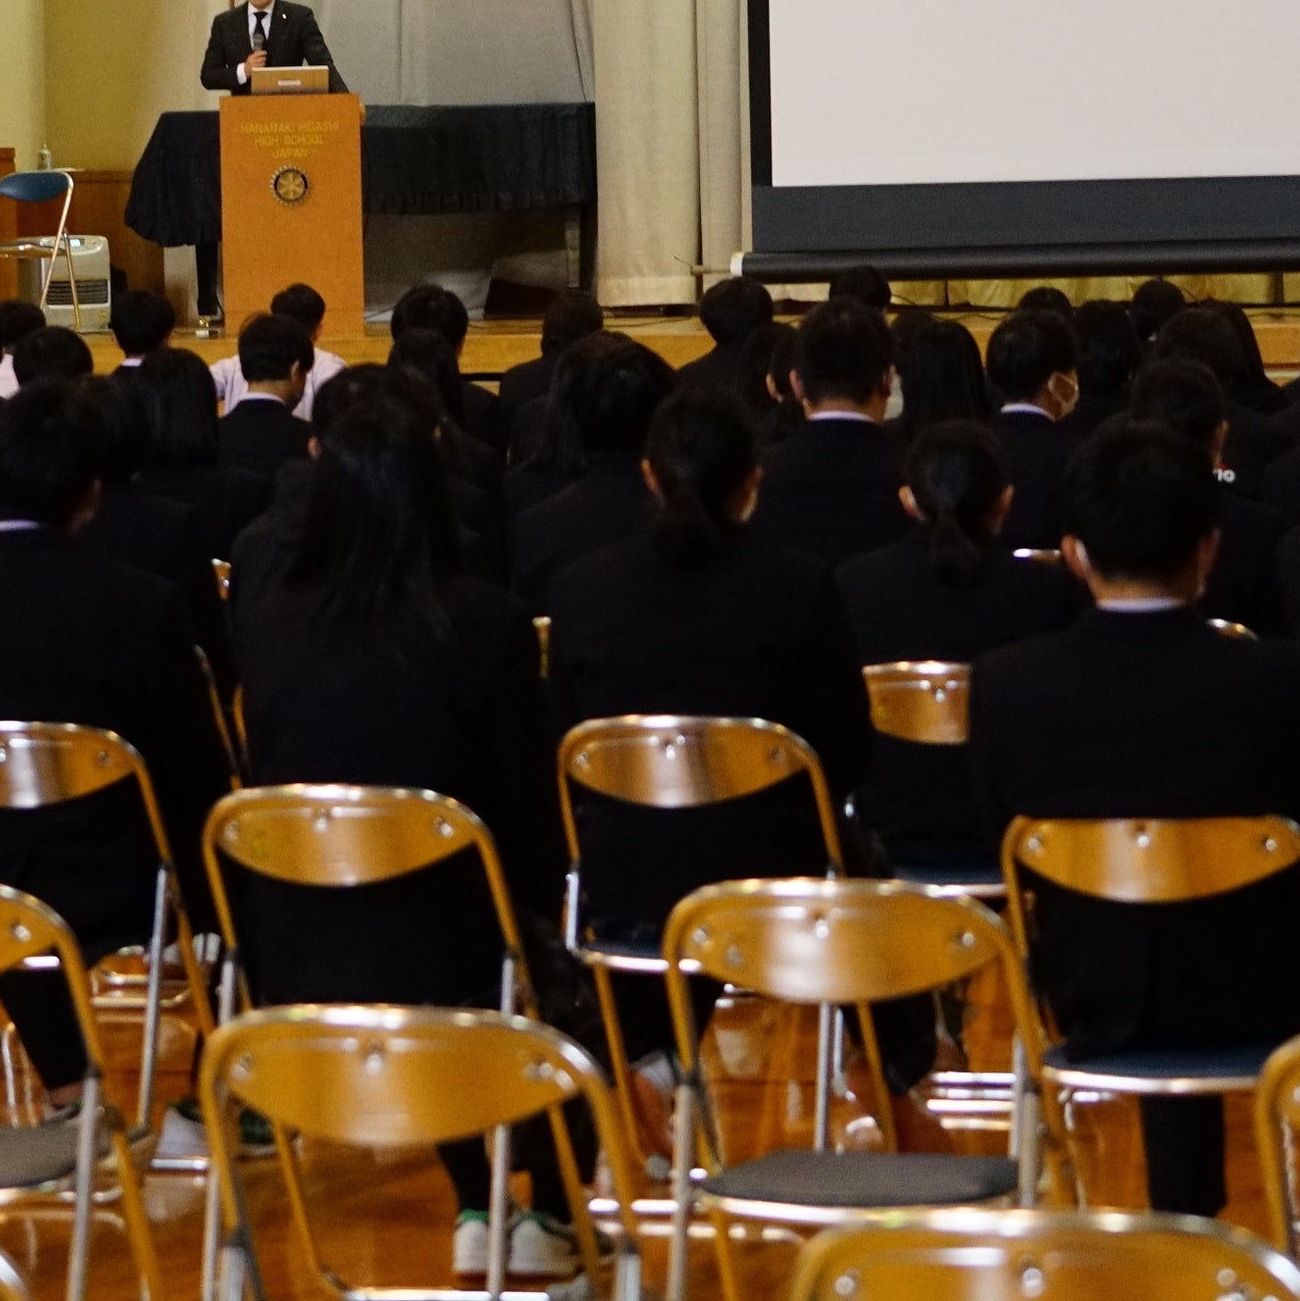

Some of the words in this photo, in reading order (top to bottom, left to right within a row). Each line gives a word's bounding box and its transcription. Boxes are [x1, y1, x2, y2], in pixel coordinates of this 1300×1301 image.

[240, 121, 295, 134] HANAMAKI
[297, 120, 340, 132] HIGASHI
[253, 135, 279, 146] HIGH
[283, 133, 324, 146] SCHOOL
[272, 147, 309, 159] JAPAN
